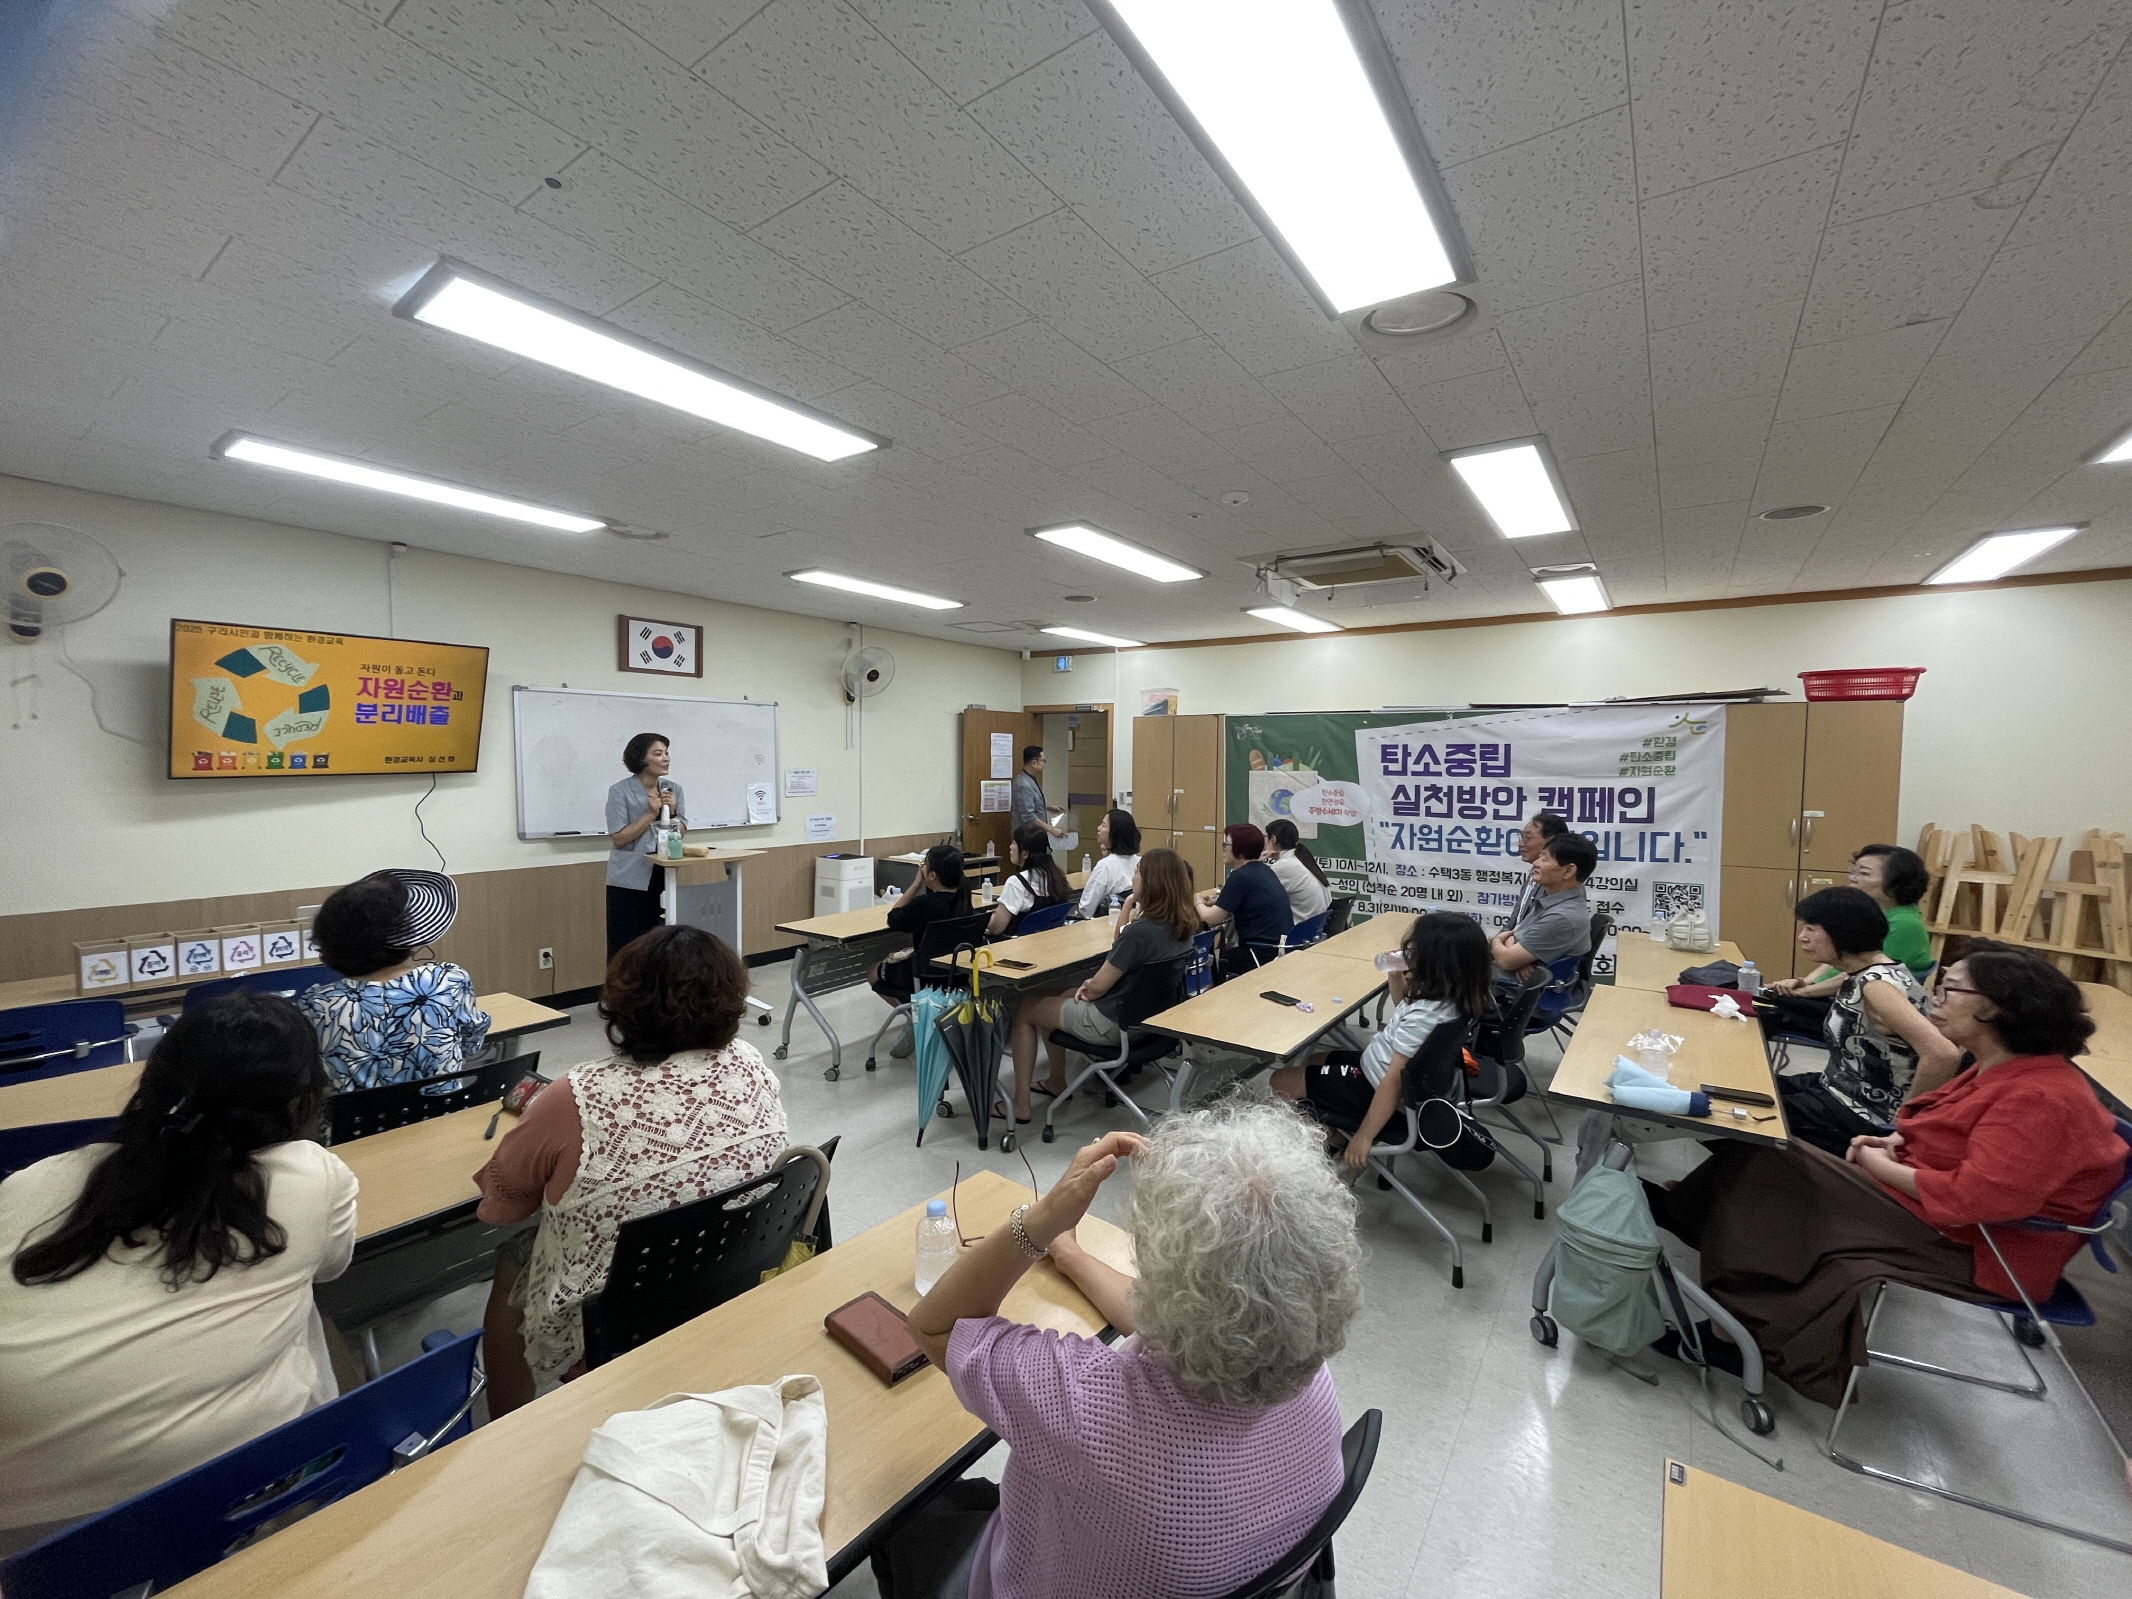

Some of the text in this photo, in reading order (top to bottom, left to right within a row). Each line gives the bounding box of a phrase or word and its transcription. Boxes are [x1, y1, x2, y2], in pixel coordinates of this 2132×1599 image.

[307, 636, 344, 645] 환경교육
[361, 664, 436, 676] 자원이 돌고 돈다
[355, 703, 450, 725] 분리배출
[1642, 736, 1677, 748] #환경
[1380, 743, 1512, 778] 탄소중립
[1619, 750, 1676, 762] #탄소중립
[1619, 765, 1676, 777] #자원순환
[1391, 784, 1656, 824] 실천방안 캠페인
[1395, 864, 1418, 878] 장소
[1428, 866, 1472, 881] 수택3동
[1362, 881, 1397, 896] (선착순
[1400, 886, 1427, 899] 20명
[1432, 888, 1443, 901] 내
[1477, 891, 1519, 907] 참가방
[1597, 900, 1625, 914] 접수
